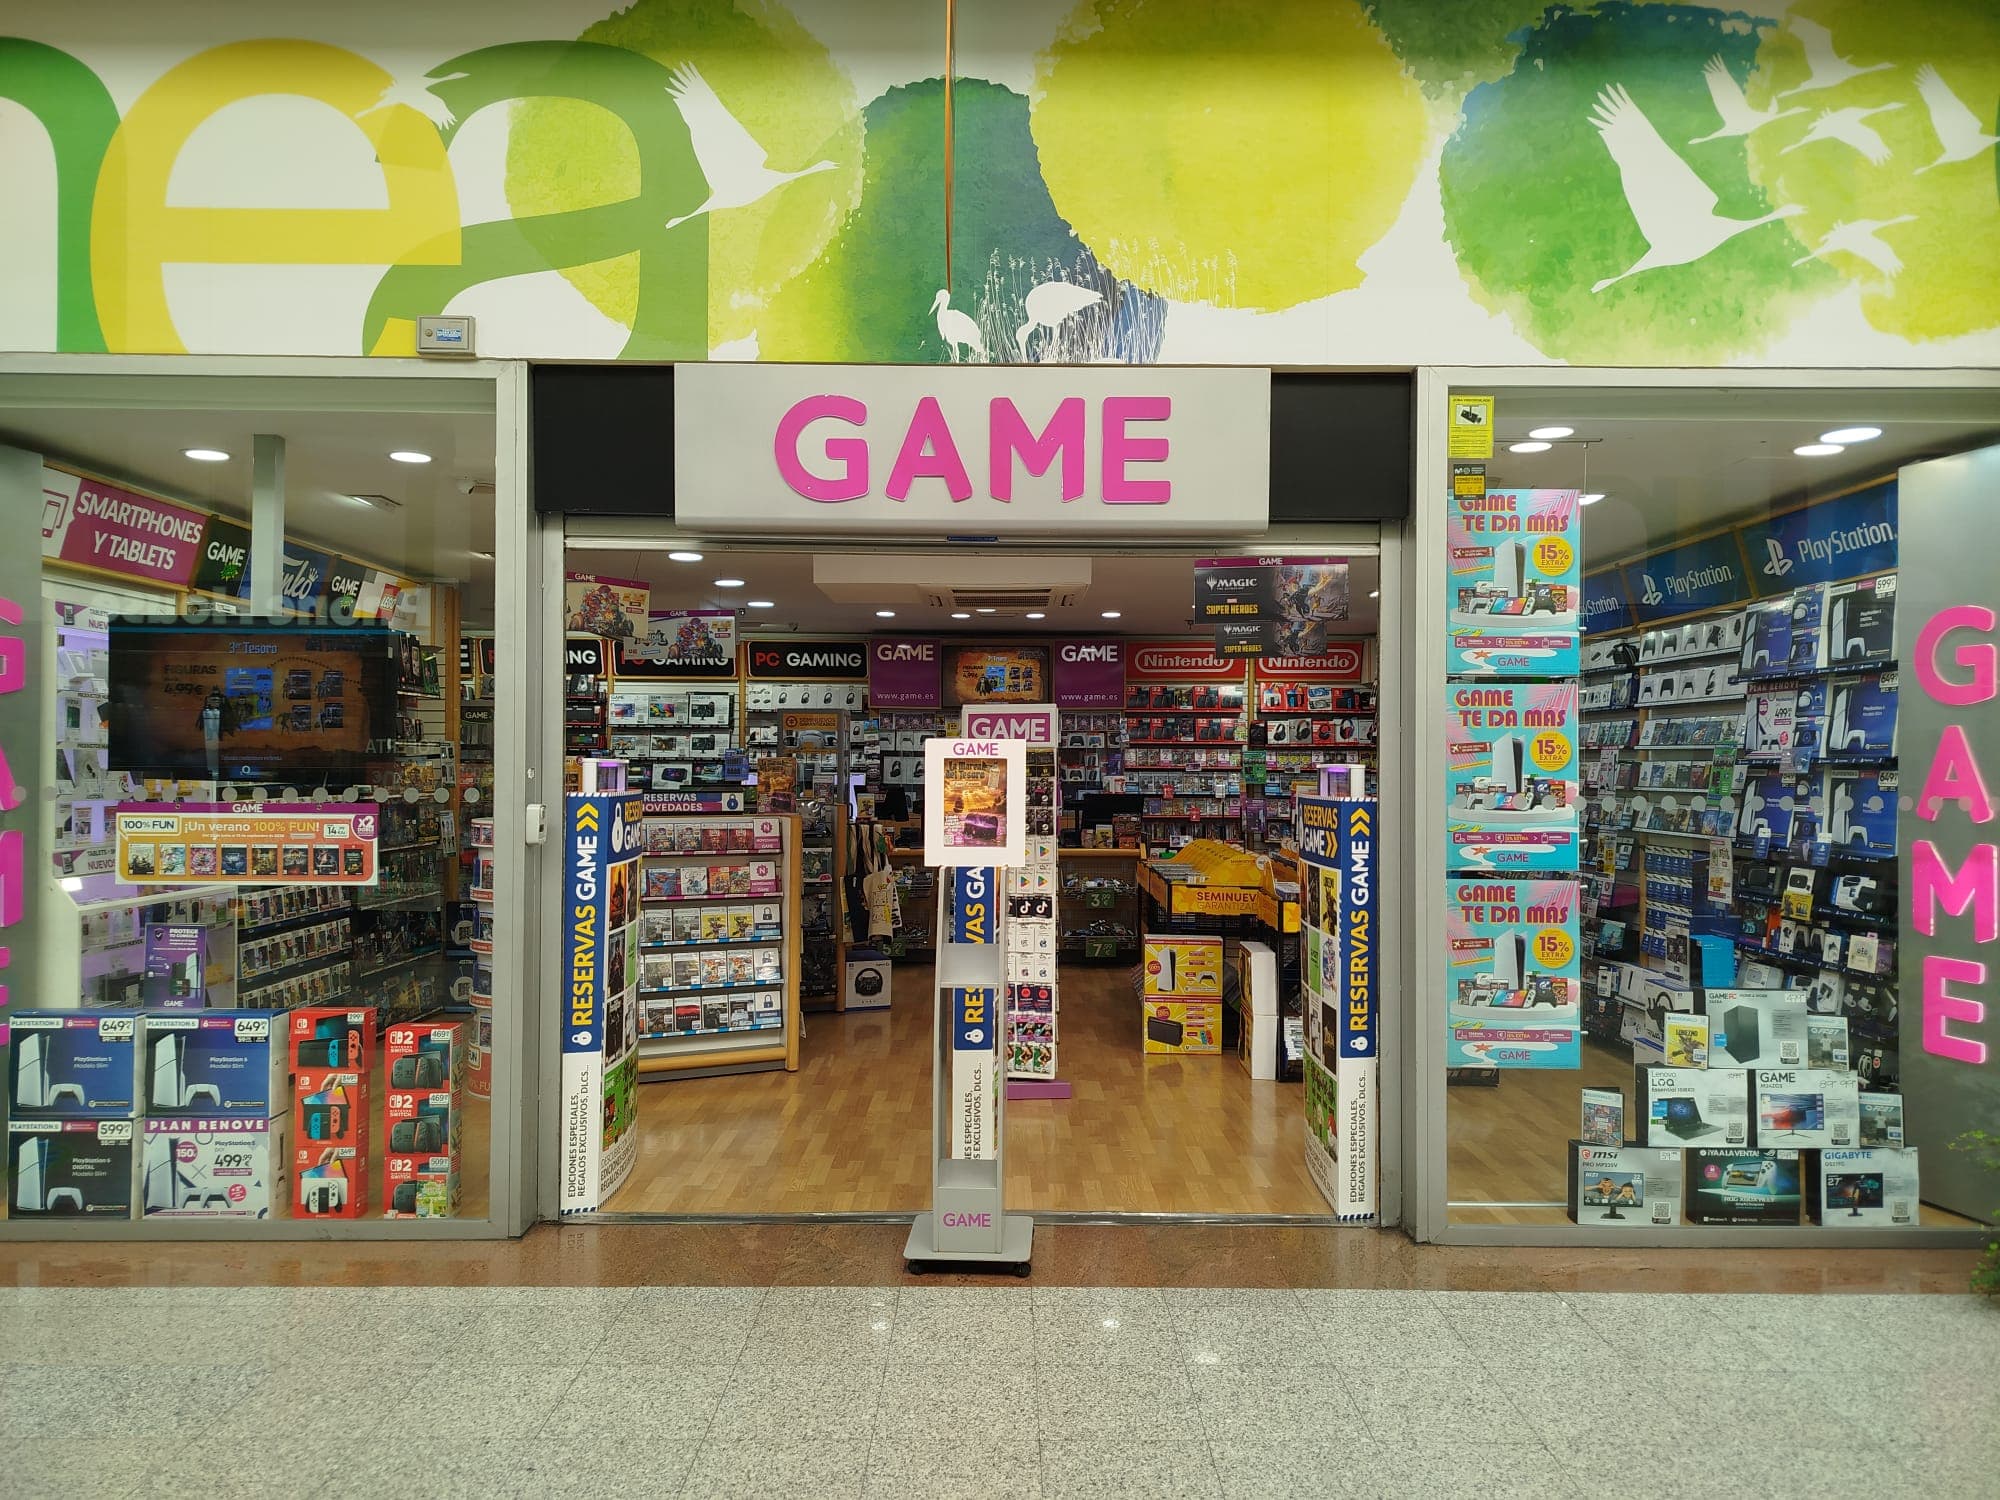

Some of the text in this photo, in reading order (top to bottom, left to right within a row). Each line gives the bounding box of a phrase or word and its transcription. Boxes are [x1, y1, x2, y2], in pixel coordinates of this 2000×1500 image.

[774, 394, 1171, 504] GAME
[1460, 495, 1517, 512] GAME
[77, 491, 204, 545] SMARTPHONES
[1463, 510, 1569, 532] TE DA MÁS
[1797, 521, 1895, 565] PlayStation
[94, 531, 176, 570] Y TABLETS
[207, 541, 246, 567] GAME
[1539, 544, 1569, 561] 15%
[1258, 558, 1284, 566] GAME
[574, 573, 596, 582] GAME
[1216, 578, 1258, 588] MAGIC
[1665, 565, 1732, 597] PlayStation
[331, 575, 360, 598] GAME
[381, 595, 397, 611] LEGO
[1206, 603, 1259, 615] SUPER HEROES
[670, 610, 688, 618] GAME
[1232, 625, 1262, 633] MAGIC
[877, 644, 935, 662] GAME
[1061, 645, 1119, 662] GAME
[1224, 644, 1263, 653] SUPER HEROES
[755, 652, 862, 667] PC GAMING
[1143, 654, 1225, 668] Nintendo
[1268, 655, 1349, 669] Nintendo
[1498, 657, 1530, 667] GAME
[164, 664, 217, 675] FIGURAS
[877, 692, 935, 701] www.game.es
[1061, 693, 1119, 701] www.game.es
[1456, 689, 1513, 706] GAME
[465, 711, 489, 719] GAME
[1459, 706, 1566, 727] TE DA MÁS
[971, 717, 1046, 742] GAME
[953, 742, 999, 756] GAME
[1536, 739, 1567, 755] 15%
[643, 793, 697, 802] RESERVAS
[232, 803, 263, 813] GAME
[1303, 804, 1338, 830] RESERVAS
[124, 820, 174, 829] 100% FUN
[210, 823, 250, 832] verano
[253, 821, 286, 832] 100%
[288, 821, 320, 832] FUN!
[1912, 605, 1998, 1065] GAME
[1303, 829, 1325, 857] GAME
[1497, 853, 1529, 863] GAME
[88, 860, 116, 871] NUEVO
[1196, 892, 1257, 902] SEMINUEV
[1457, 885, 1516, 902] GAME
[1461, 902, 1569, 923] TE DA MÁS
[572, 836, 598, 1026] RESERVAS GAME
[1350, 841, 1369, 1031] RESERVAS GAME
[1539, 936, 1569, 952] 15%
[101, 1020, 125, 1031] 649
[237, 1021, 260, 1032] 649
[402, 1032, 414, 1045] 2
[1499, 1050, 1531, 1061] GAME
[1651, 1079, 1675, 1087] LOQ
[1760, 1072, 1796, 1083] GAME
[402, 1096, 414, 1108] 2
[964, 1090, 973, 1146] ESPECIALES,
[973, 1092, 982, 1152] EXCLUSIVOS,
[100, 1123, 124, 1135] 599
[150, 1120, 264, 1131] PLAN RENOVE
[579, 1097, 589, 1156] EXCLUSIVOS,
[1358, 1100, 1366, 1160] EXCLUSIVOS,
[568, 1092, 579, 1198] EDICIONES ESPECIALES,
[1350, 1097, 1359, 1203] EDICIONES ESPECIALES,
[1592, 1151, 1618, 1159] msi
[1734, 1149, 1760, 1157] VENTA!
[1824, 1151, 1872, 1160] GIGABYTE
[214, 1155, 242, 1167] 499
[402, 1160, 413, 1172] 2
[577, 1158, 587, 1197] REGALOS
[1358, 1161, 1366, 1203] REGALOS
[943, 1213, 992, 1228] GAME
